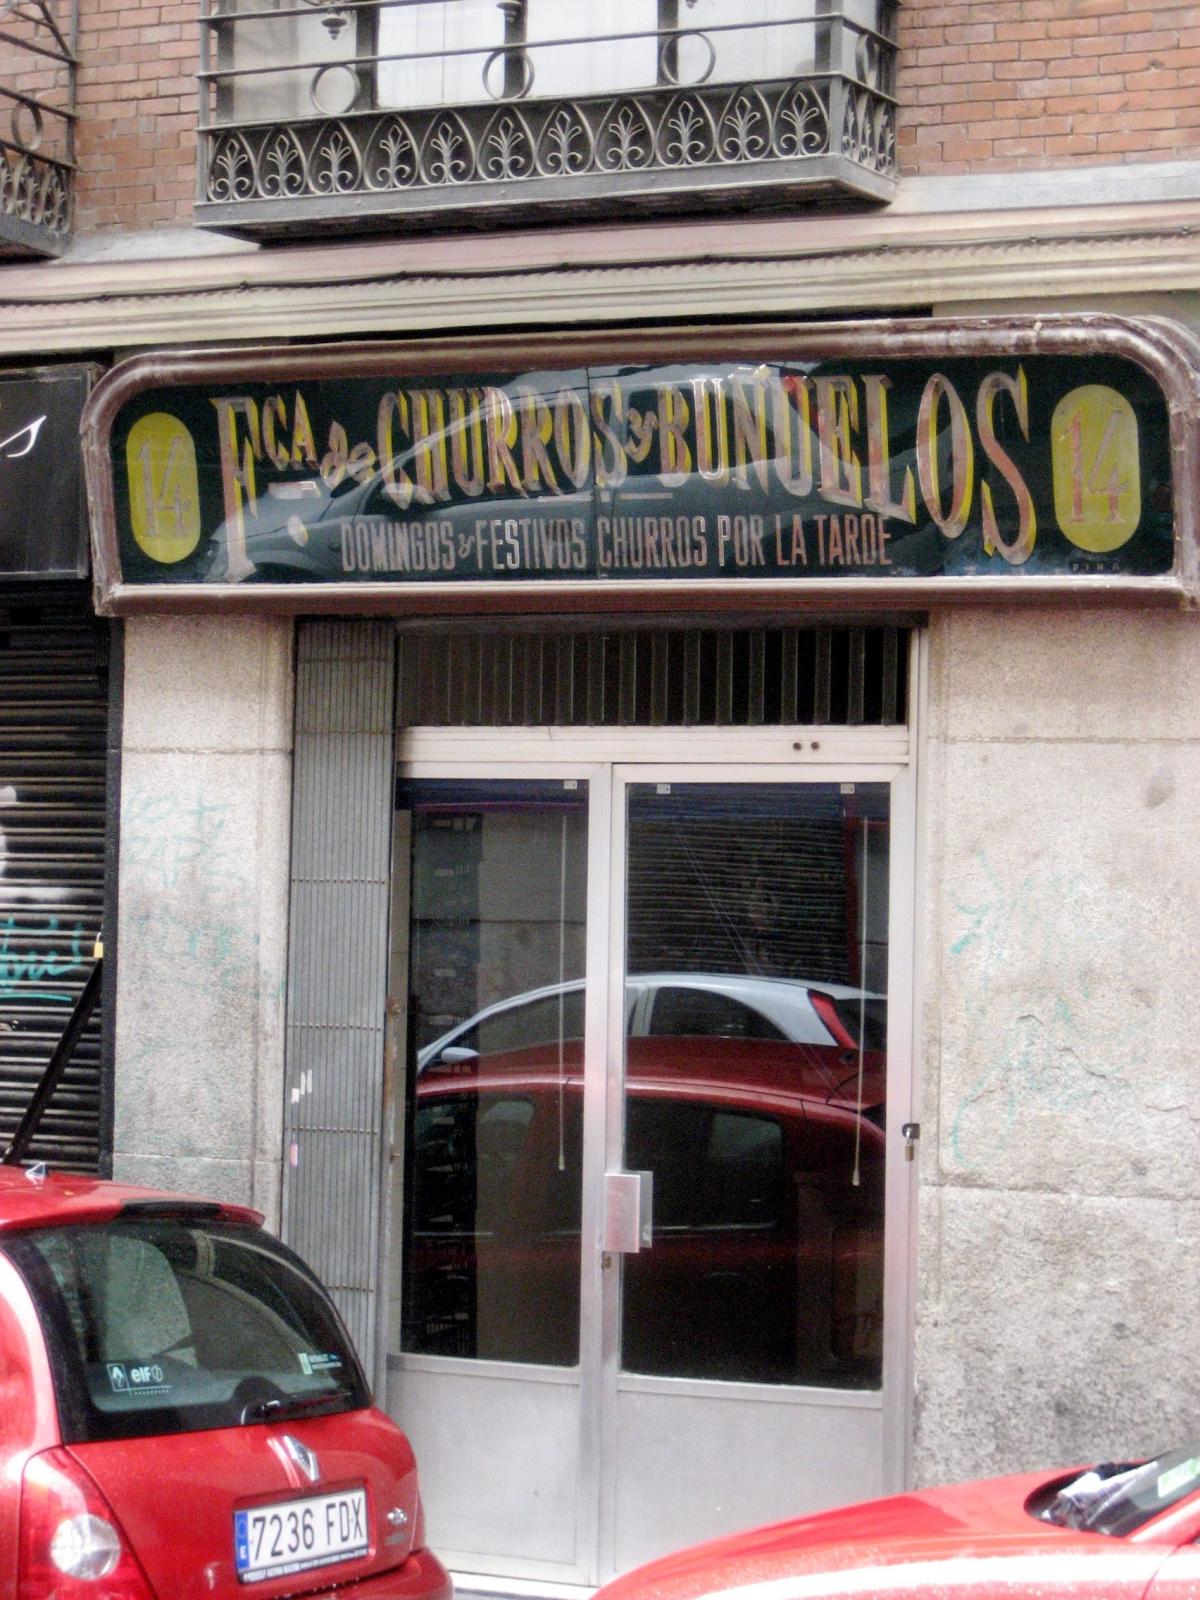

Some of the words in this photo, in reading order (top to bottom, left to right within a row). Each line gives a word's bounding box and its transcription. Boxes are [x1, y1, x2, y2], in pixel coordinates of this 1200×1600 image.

[135, 436, 192, 538] 14
[320, 420, 376, 490] de
[377, 378, 628, 510] CHURROS
[1060, 408, 1129, 524] 14
[341, 518, 456, 572] DOMINGOS
[475, 518, 588, 570] FESTIVOS
[597, 515, 708, 568] CHURROS
[717, 514, 766, 567] POR
[775, 513, 808, 566] LA
[813, 513, 893, 566] TARDE
[252, 1507, 315, 1561] 7236
[325, 1497, 364, 1546] FDX
